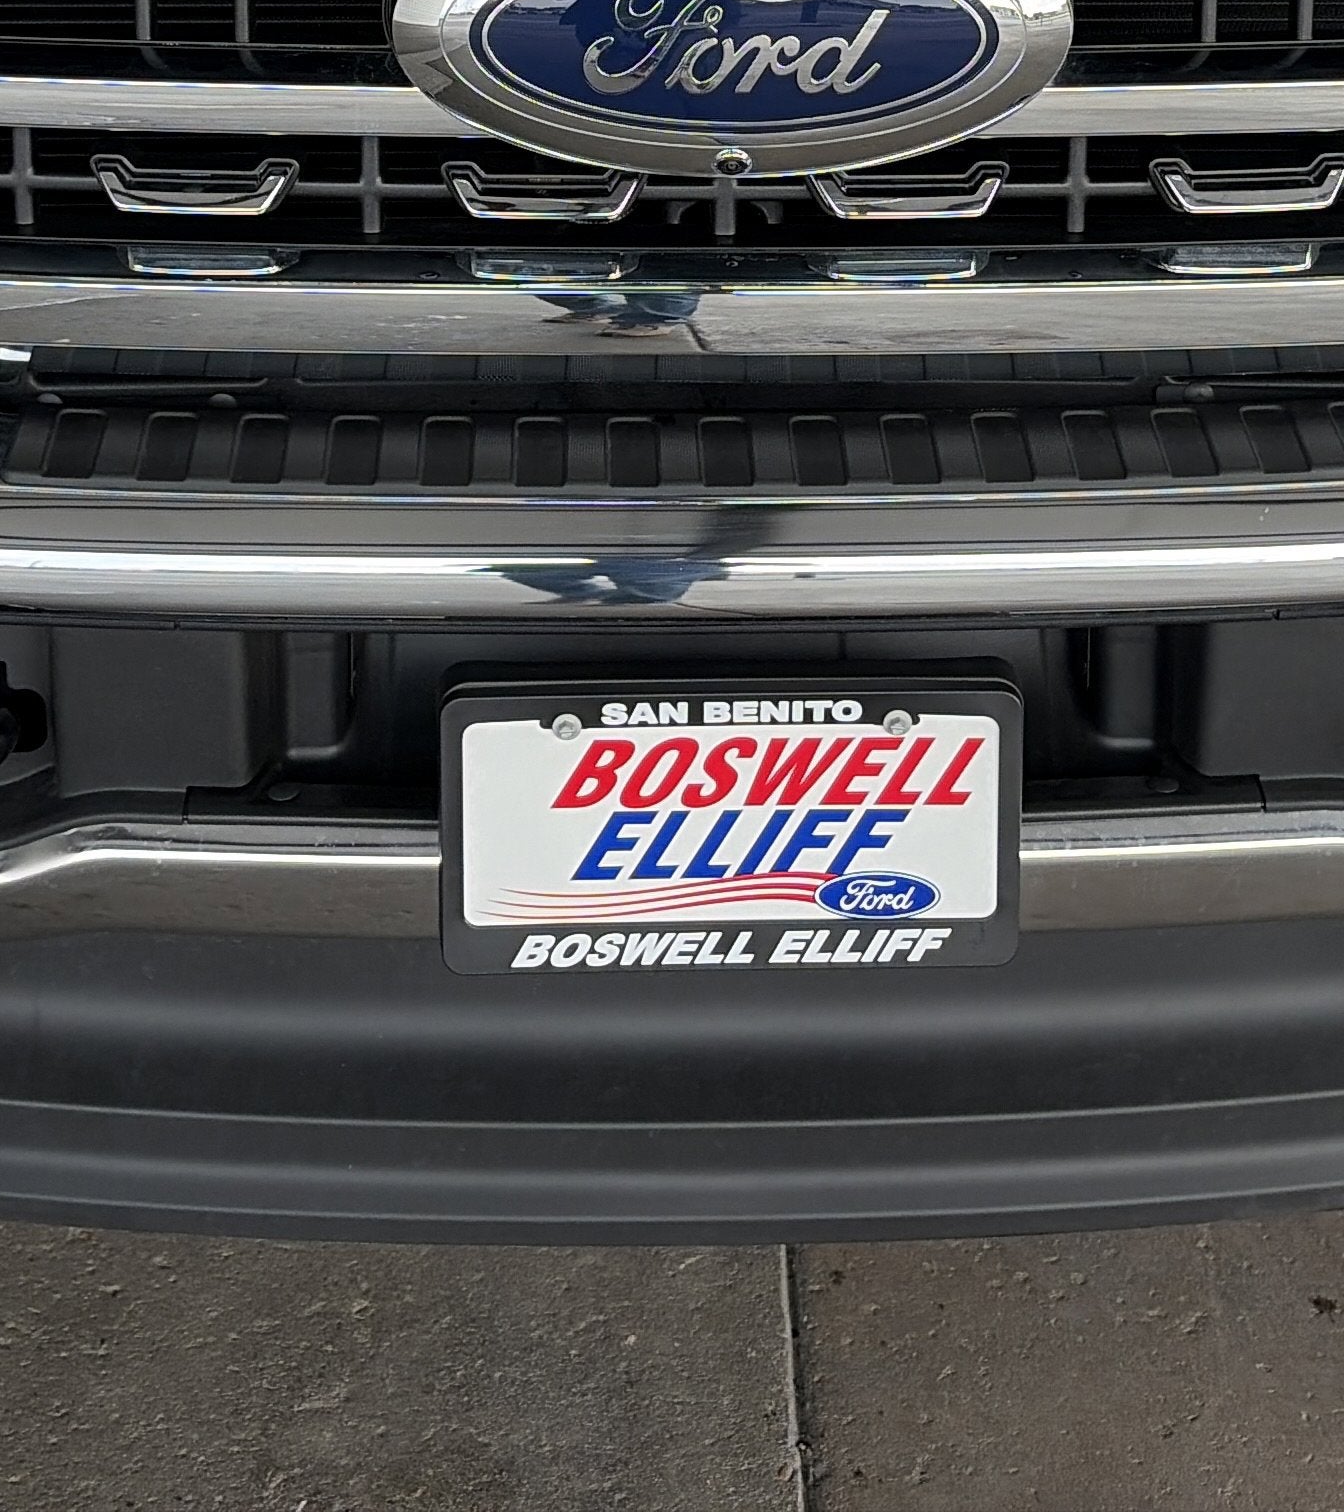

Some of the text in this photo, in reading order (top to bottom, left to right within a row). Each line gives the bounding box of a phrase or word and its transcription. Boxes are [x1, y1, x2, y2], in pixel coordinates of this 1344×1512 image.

[600, 699, 863, 726] SAN BENITO
[551, 736, 986, 809] BOSWELL
[570, 808, 912, 881] ELLIFF
[838, 879, 916, 912] Ford
[511, 927, 953, 969] BOSWELL ELLIFF
